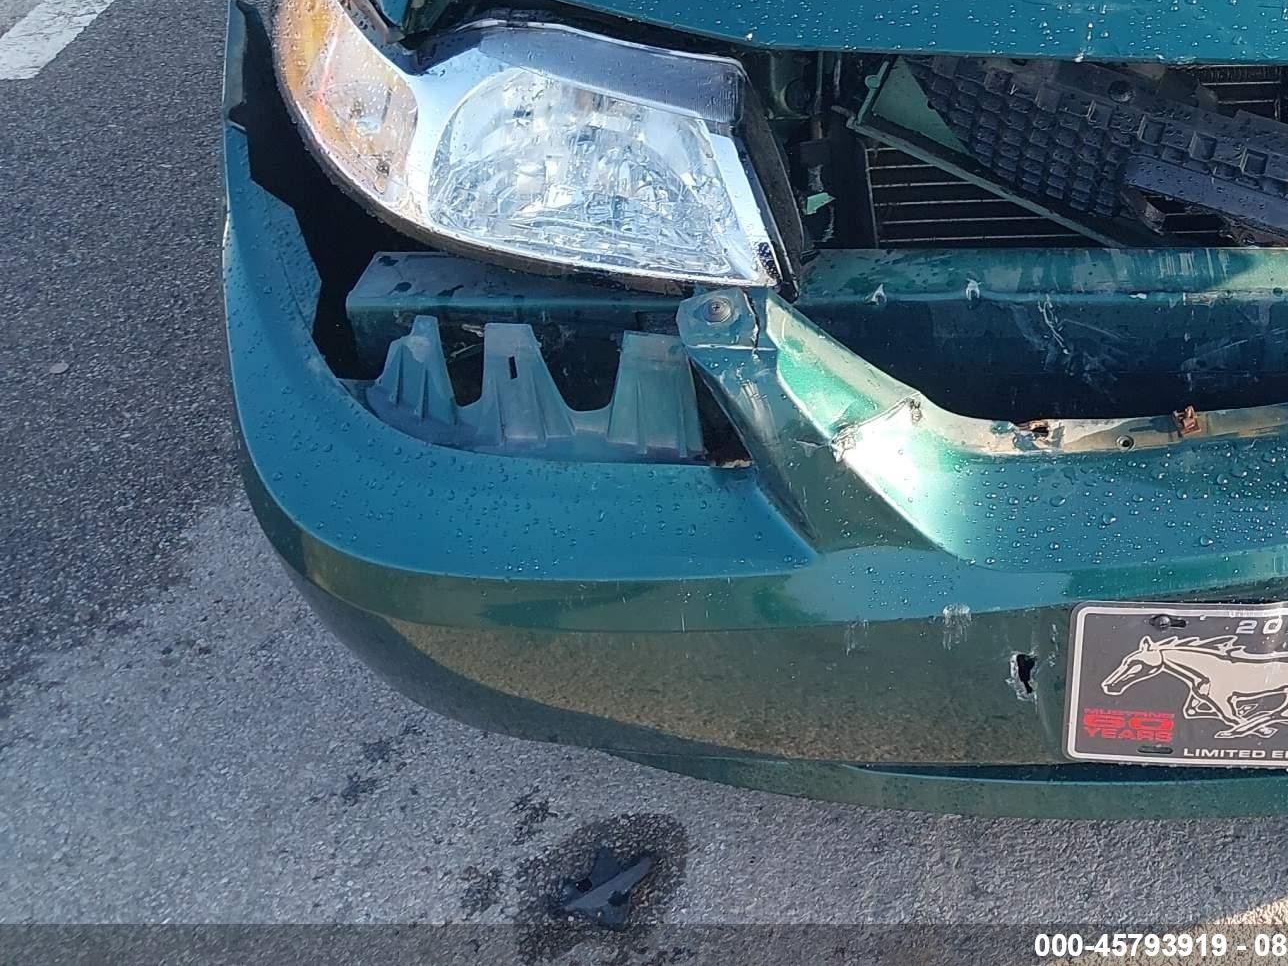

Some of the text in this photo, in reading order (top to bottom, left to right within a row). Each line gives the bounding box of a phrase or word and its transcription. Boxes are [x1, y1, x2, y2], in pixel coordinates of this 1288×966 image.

[1083, 714, 1174, 731] 60
[1084, 726, 1173, 742] YEARS
[1184, 748, 1266, 760] LIMITED
